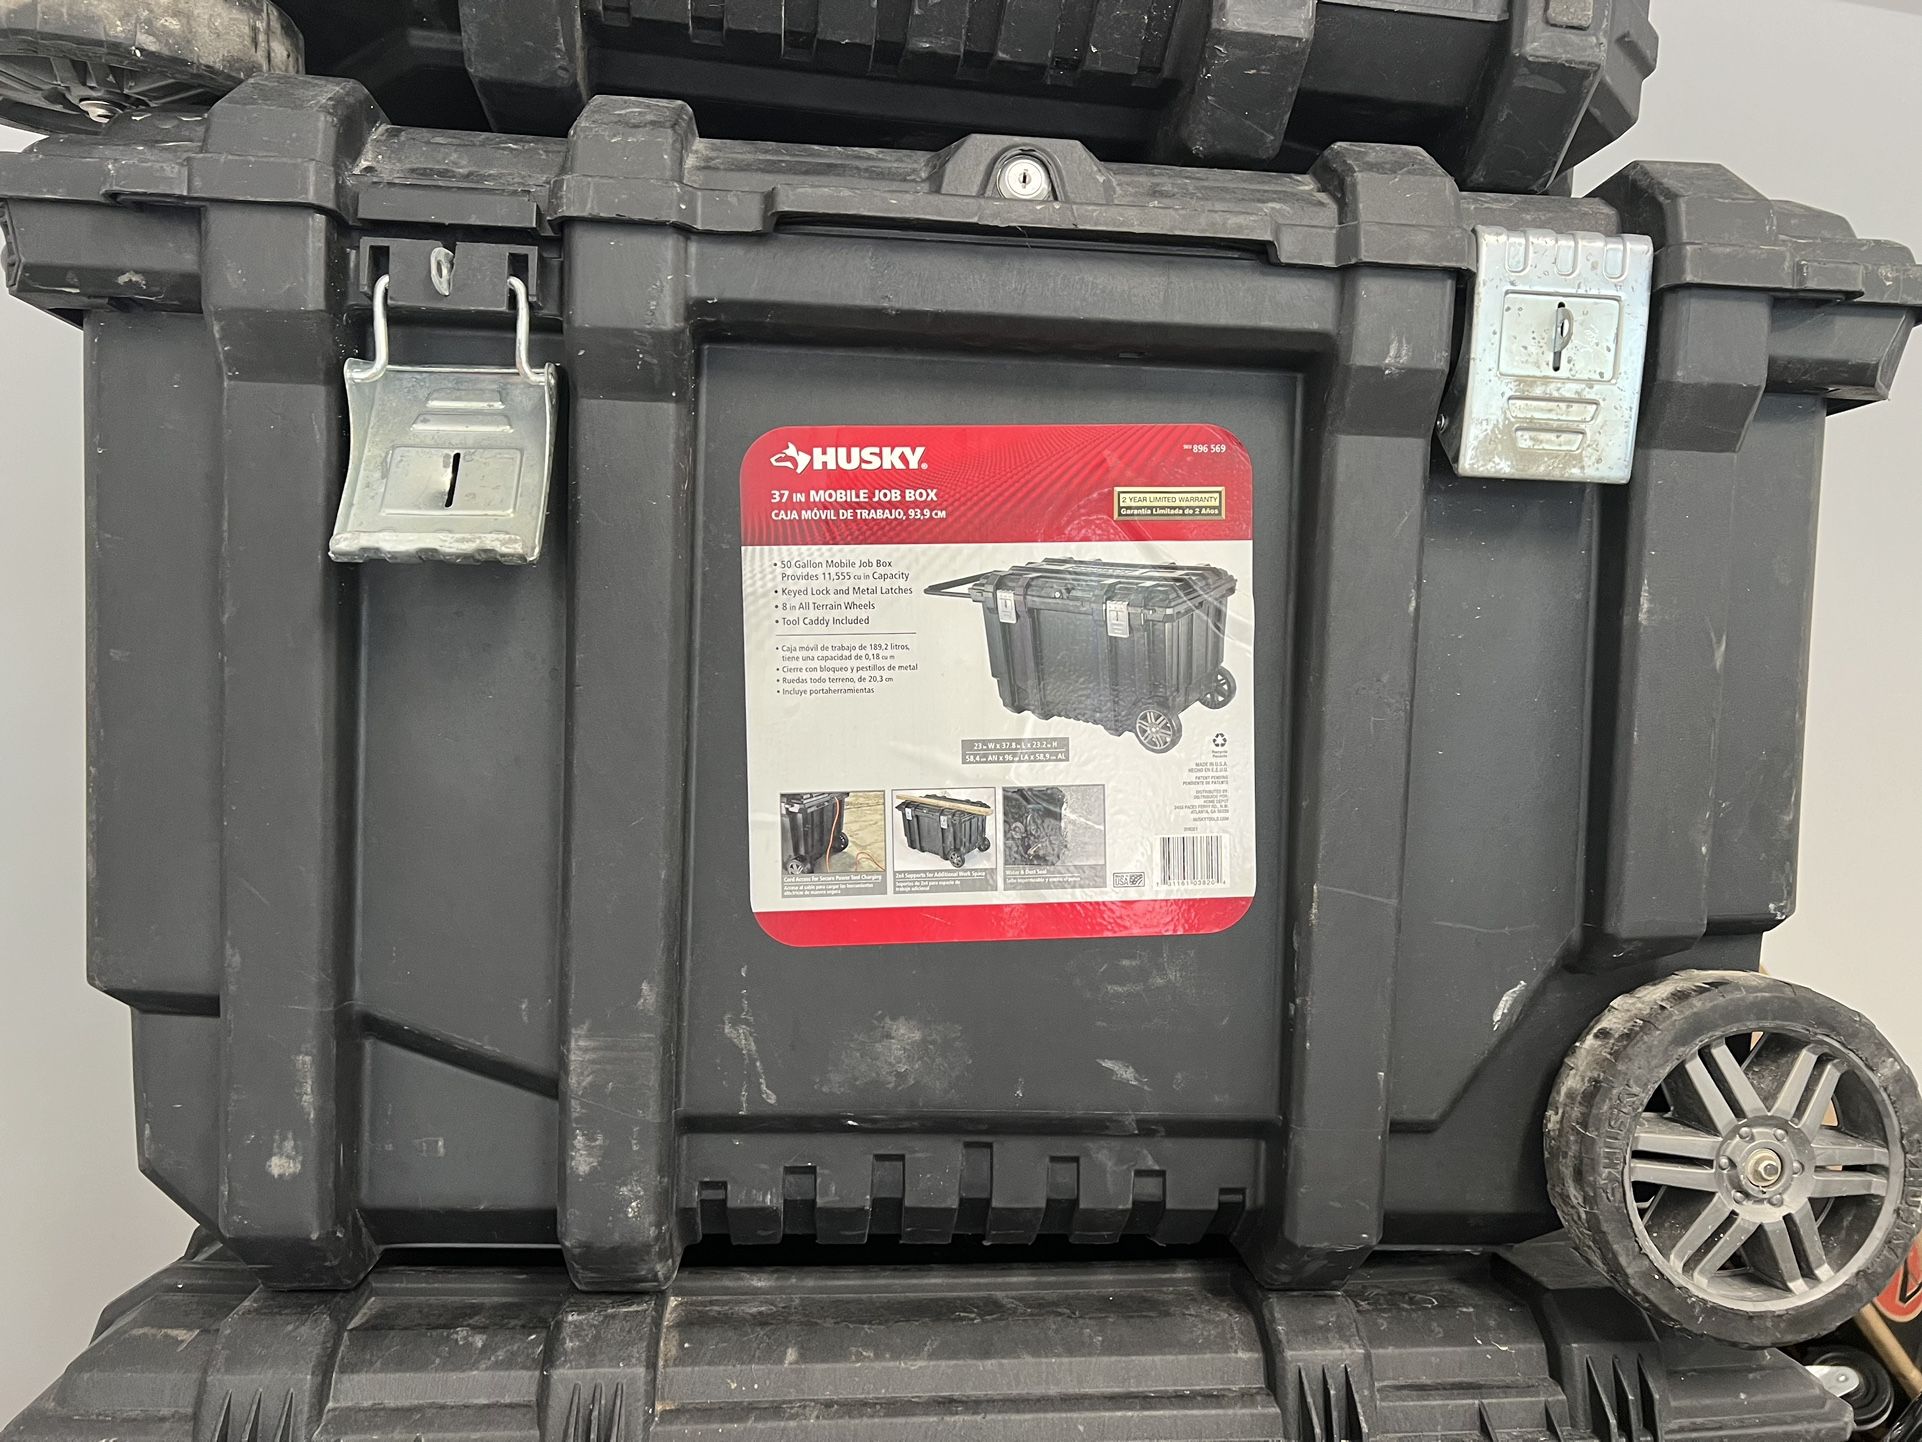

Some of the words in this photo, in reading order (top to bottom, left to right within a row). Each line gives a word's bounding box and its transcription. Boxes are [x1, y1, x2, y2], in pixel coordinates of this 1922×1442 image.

[1193, 444, 1208, 453] 896
[1211, 444, 1226, 453] 569
[771, 490, 789, 503] 37
[793, 492, 805, 502] IN
[810, 490, 869, 502] MOBILE
[872, 489, 901, 502] JOB
[905, 489, 938, 501] BOX
[771, 510, 799, 520] CAJA
[802, 508, 836, 520] MÓVIL
[839, 510, 853, 520] DE
[856, 509, 906, 520] TRABAJO,
[908, 509, 930, 520] 93,9
[932, 510, 946, 519] CM
[781, 560, 792, 569] 50
[795, 560, 823, 569] Gallon
[826, 560, 856, 568] Mobile
[859, 559, 873, 568] Job
[876, 559, 892, 568] Box
[781, 573, 818, 581] Provides
[822, 572, 851, 581] 11,555
[872, 571, 909, 582] Capacity
[782, 587, 808, 598] Keyed
[811, 587, 830, 595] Lock
[834, 587, 850, 595] and
[853, 586, 877, 595] Metal
[880, 586, 912, 595] Latches
[782, 603, 787, 611] 8
[798, 602, 810, 610] All
[813, 602, 842, 610] Terrain
[844, 601, 875, 609] Wheels
[782, 617, 799, 625] Tool
[803, 617, 830, 627] Caddy
[832, 616, 869, 625] Included
[781, 645, 796, 653] Caja
[799, 644, 818, 652] móvil
[831, 644, 856, 652] trabajo
[858, 643, 867, 651] de
[782, 654, 800, 662] tiene
[817, 654, 852, 662] capacidad
[865, 653, 880, 661] 0,18
[820, 665, 848, 673] bloqueo
[856, 665, 885, 673] pestillos
[783, 688, 808, 696] Incluye
[809, 687, 874, 696] portaherramientas
